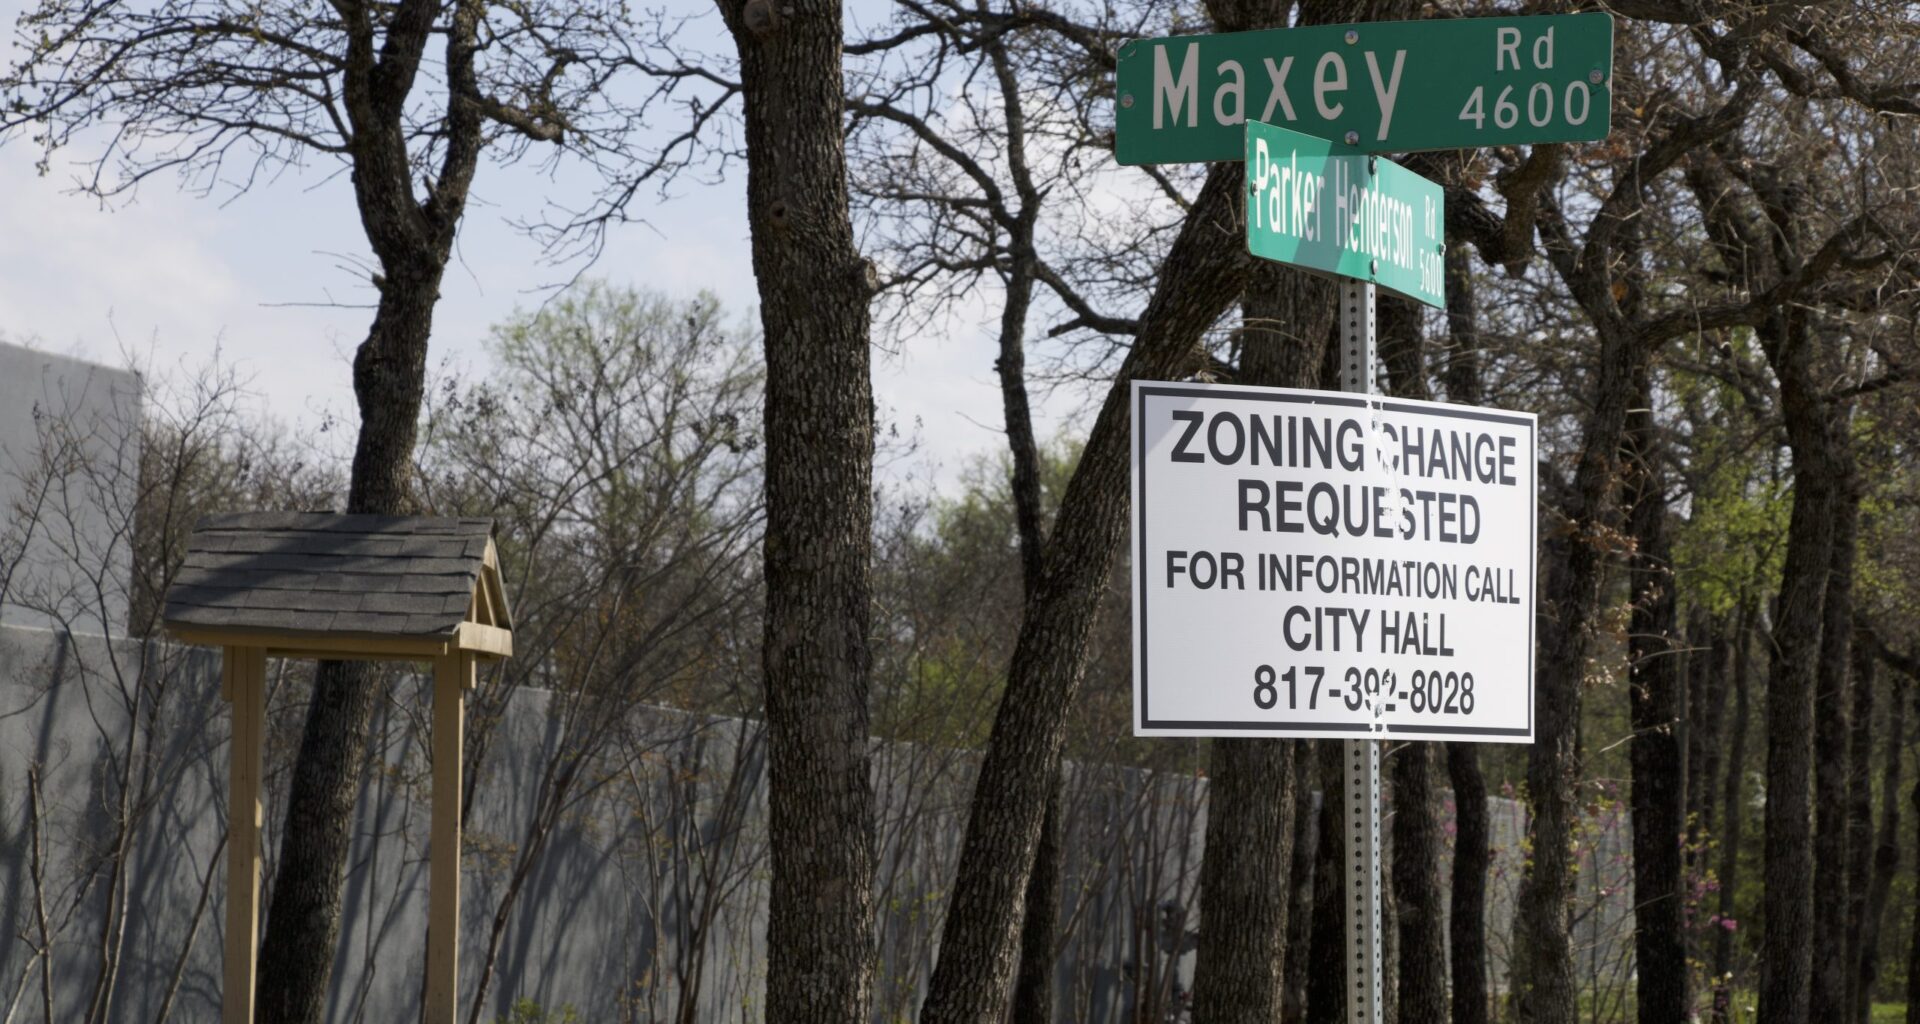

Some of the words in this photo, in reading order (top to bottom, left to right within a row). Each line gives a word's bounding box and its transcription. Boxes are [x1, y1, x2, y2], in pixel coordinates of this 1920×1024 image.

[1496, 26, 1555, 71] Rd
[1152, 42, 1407, 141] Maxey
[1458, 80, 1591, 130] 4600
[1255, 138, 1325, 243] Parker
[1335, 159, 1414, 271] Henderson
[1424, 195, 1436, 241] Rd
[1419, 248, 1442, 298] 5600
[1170, 410, 1364, 471] ZONING
[1238, 478, 1480, 544] REQUESTED
[1166, 550, 1245, 590] FOR
[1258, 553, 1457, 600] INFORMATION
[1465, 565, 1520, 604] CALL
[1283, 605, 1370, 652] CITY
[1381, 610, 1454, 657] HALL
